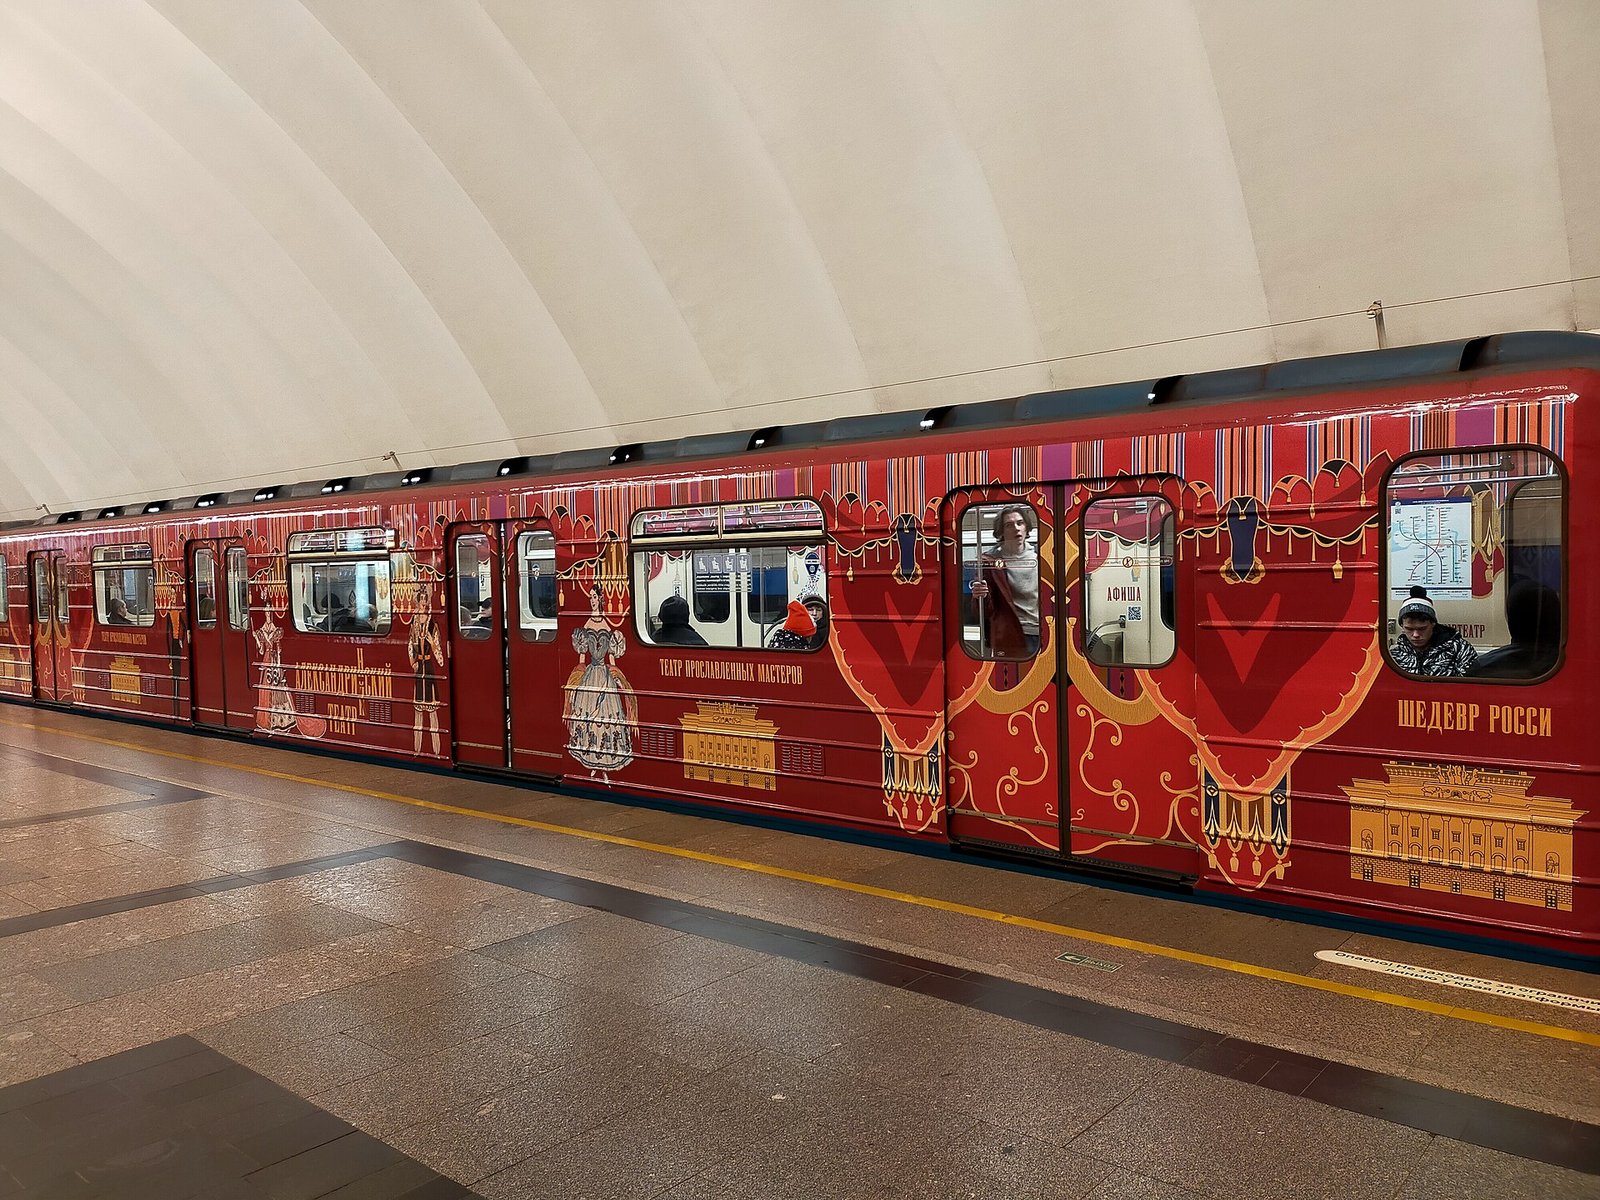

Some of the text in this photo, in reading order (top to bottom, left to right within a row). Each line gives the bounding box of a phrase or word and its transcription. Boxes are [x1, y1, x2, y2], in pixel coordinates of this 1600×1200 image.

[1107, 586, 1142, 602] АФИША
[659, 658, 803, 685] ТЕАТР ПРОСЛАВЛЕННЫХ МАСТЕРОВ
[327, 704, 358, 736] ТЕАТР
[1398, 699, 1552, 737] ШЕДЕВР РОССИ
[1335, 951, 1393, 967] Опасно!
[1396, 963, 1416, 971] Не
[1418, 969, 1493, 986] заходите
[1384, 968, 1438, 981] линию
[1453, 981, 1493, 992] края
